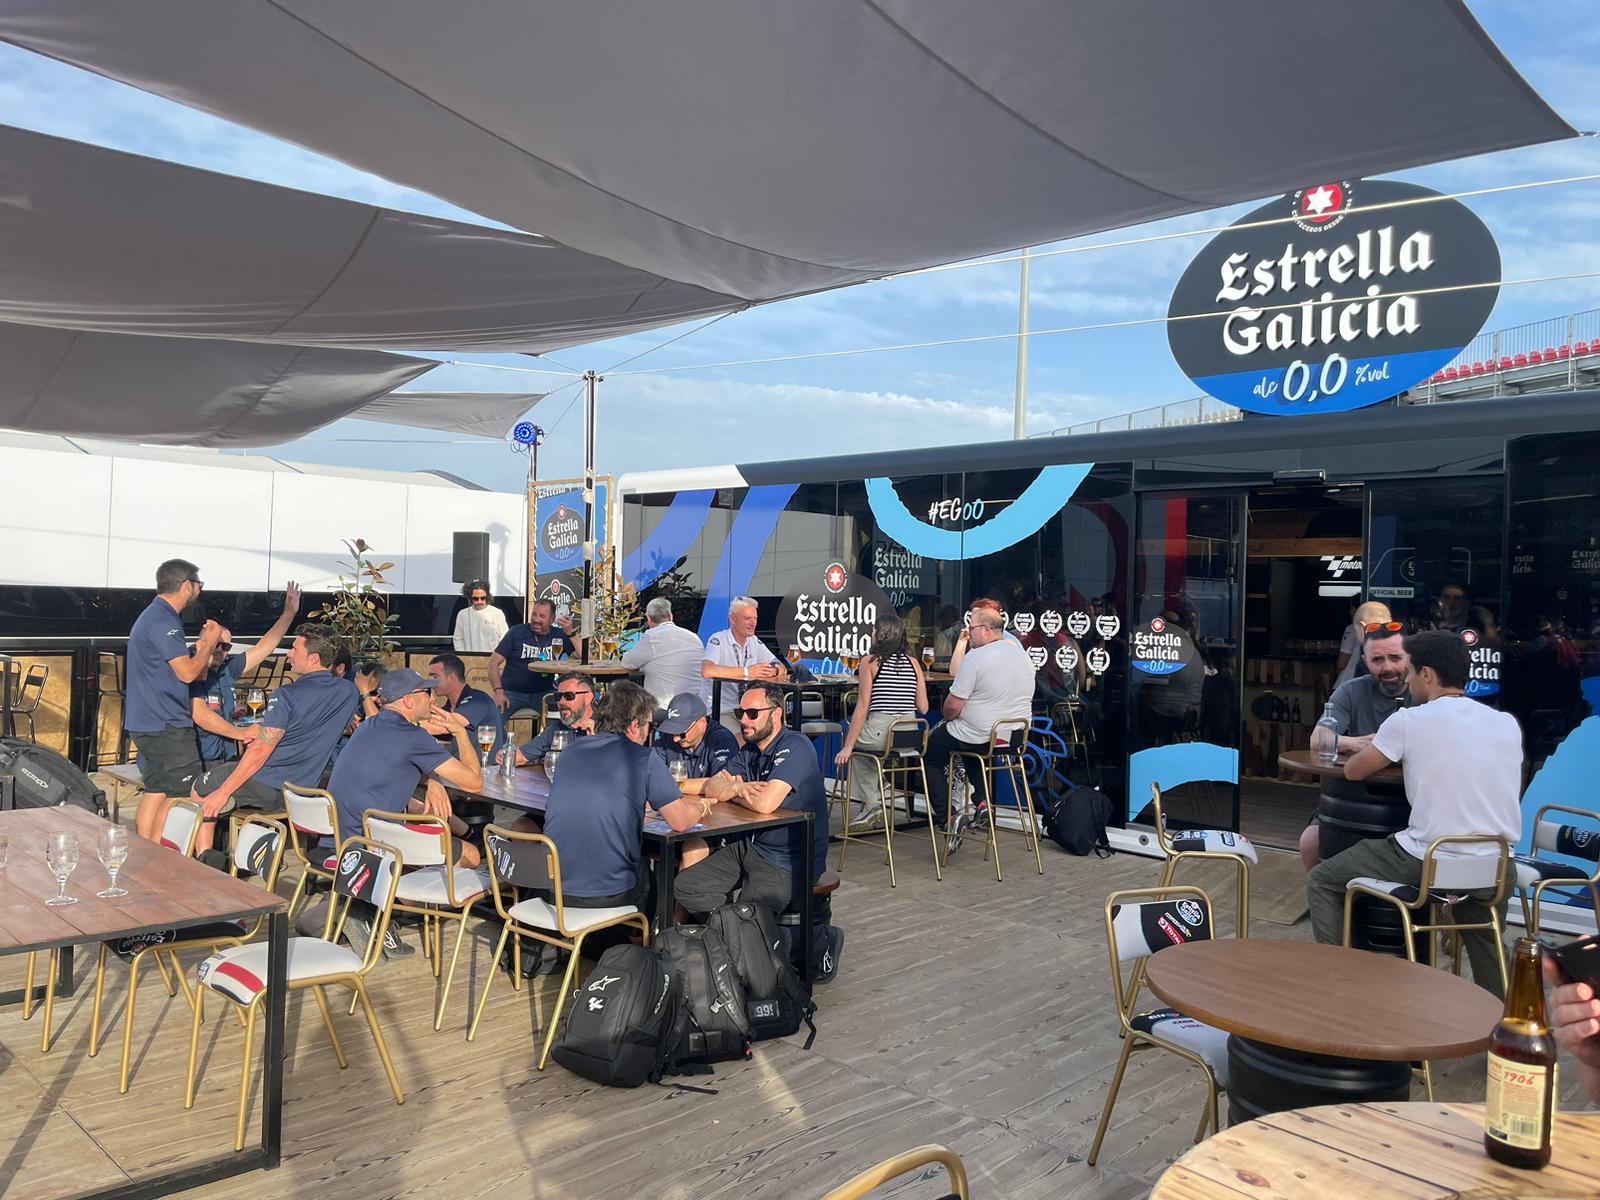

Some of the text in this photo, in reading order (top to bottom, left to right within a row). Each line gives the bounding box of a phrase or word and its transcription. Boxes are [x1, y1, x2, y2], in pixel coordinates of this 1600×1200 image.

[1215, 225, 1435, 303] Estrella
[1222, 284, 1422, 356] Galicia
[1253, 376, 1279, 399] alc
[1282, 352, 1348, 402] 0,0
[547, 518, 579, 536] Estrella
[549, 532, 578, 549] Galicia
[873, 546, 922, 569] Estrella
[875, 567, 920, 589] Galicia
[794, 593, 877, 626] Estrella
[796, 622, 872, 656] Galicia
[1134, 631, 1182, 647] Estrella
[1135, 645, 1180, 661] Galicia
[1469, 647, 1501, 664] ella
[1503, 1071, 1535, 1086] 1906
